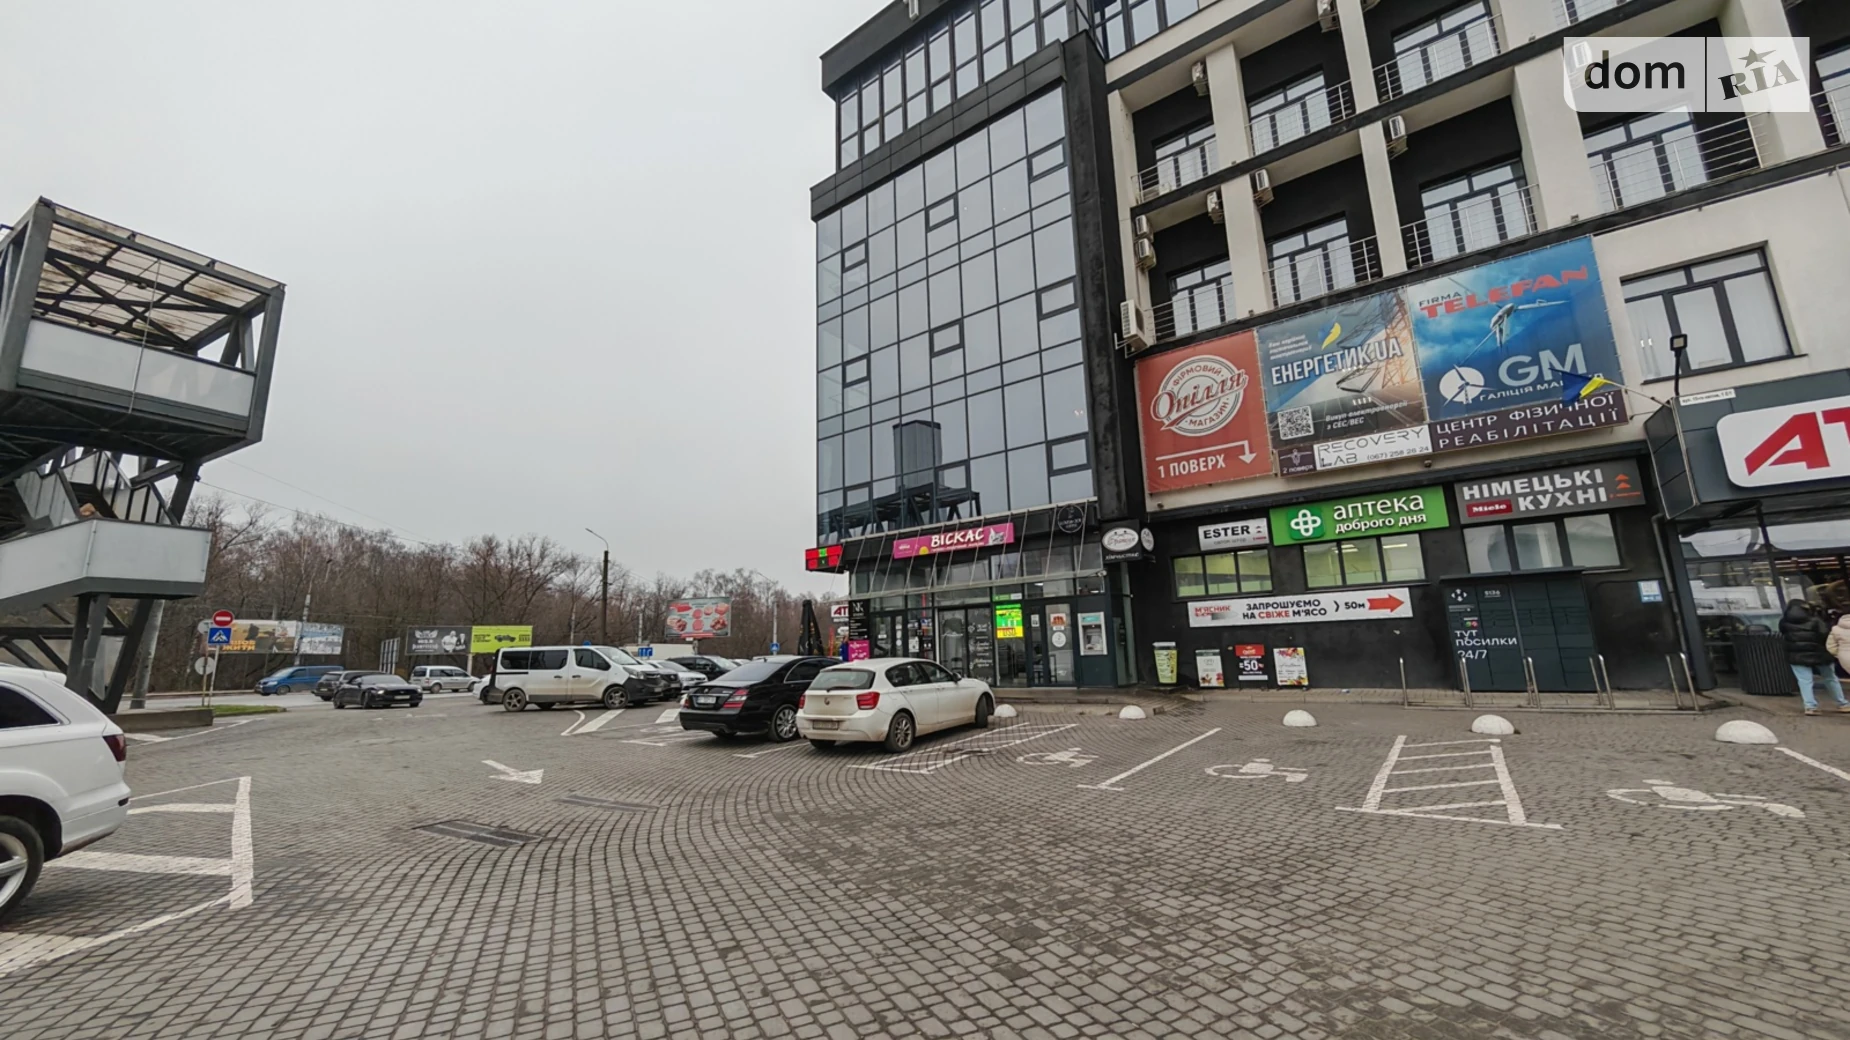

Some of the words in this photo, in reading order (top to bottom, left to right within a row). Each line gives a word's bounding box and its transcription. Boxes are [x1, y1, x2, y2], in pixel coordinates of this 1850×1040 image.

[1419, 291, 1462, 307] FIRMA
[1420, 265, 1588, 319] TELEFAN
[1173, 365, 1222, 387] ФІРМОВИЙ
[1499, 343, 1588, 387] GM
[1152, 370, 1246, 421] Опілля
[1480, 386, 1533, 401] ГАЛІЦІЯ
[1189, 401, 1230, 427] МАГАЗИН
[1436, 415, 1498, 434] ЦЕНТР
[1439, 407, 1619, 449] РЕАБІЛІТАЦІЇ
[1318, 427, 1424, 455] RECOVERY
[1158, 465, 1165, 478] 1
[1170, 454, 1226, 477] ПОВЕРХ
[1320, 452, 1358, 467] LAB
[1367, 452, 1387, 461] (067)
[1462, 468, 1604, 501] НІМЕЦЬКІ
[1333, 493, 1425, 521] аптека
[1472, 502, 1507, 513] Miele
[1518, 487, 1608, 512] КУХНІ
[1203, 525, 1251, 539] ESTER
[1335, 517, 1395, 535] доброго
[1398, 513, 1427, 527] дня
[931, 528, 985, 548] ВІСКАС
[1243, 611, 1256, 620] НА
[1258, 610, 1290, 619] СВІЖЕ
[1292, 608, 1327, 617] М'ЯСО
[1246, 599, 1321, 612] ЗАПРОШУЄМО
